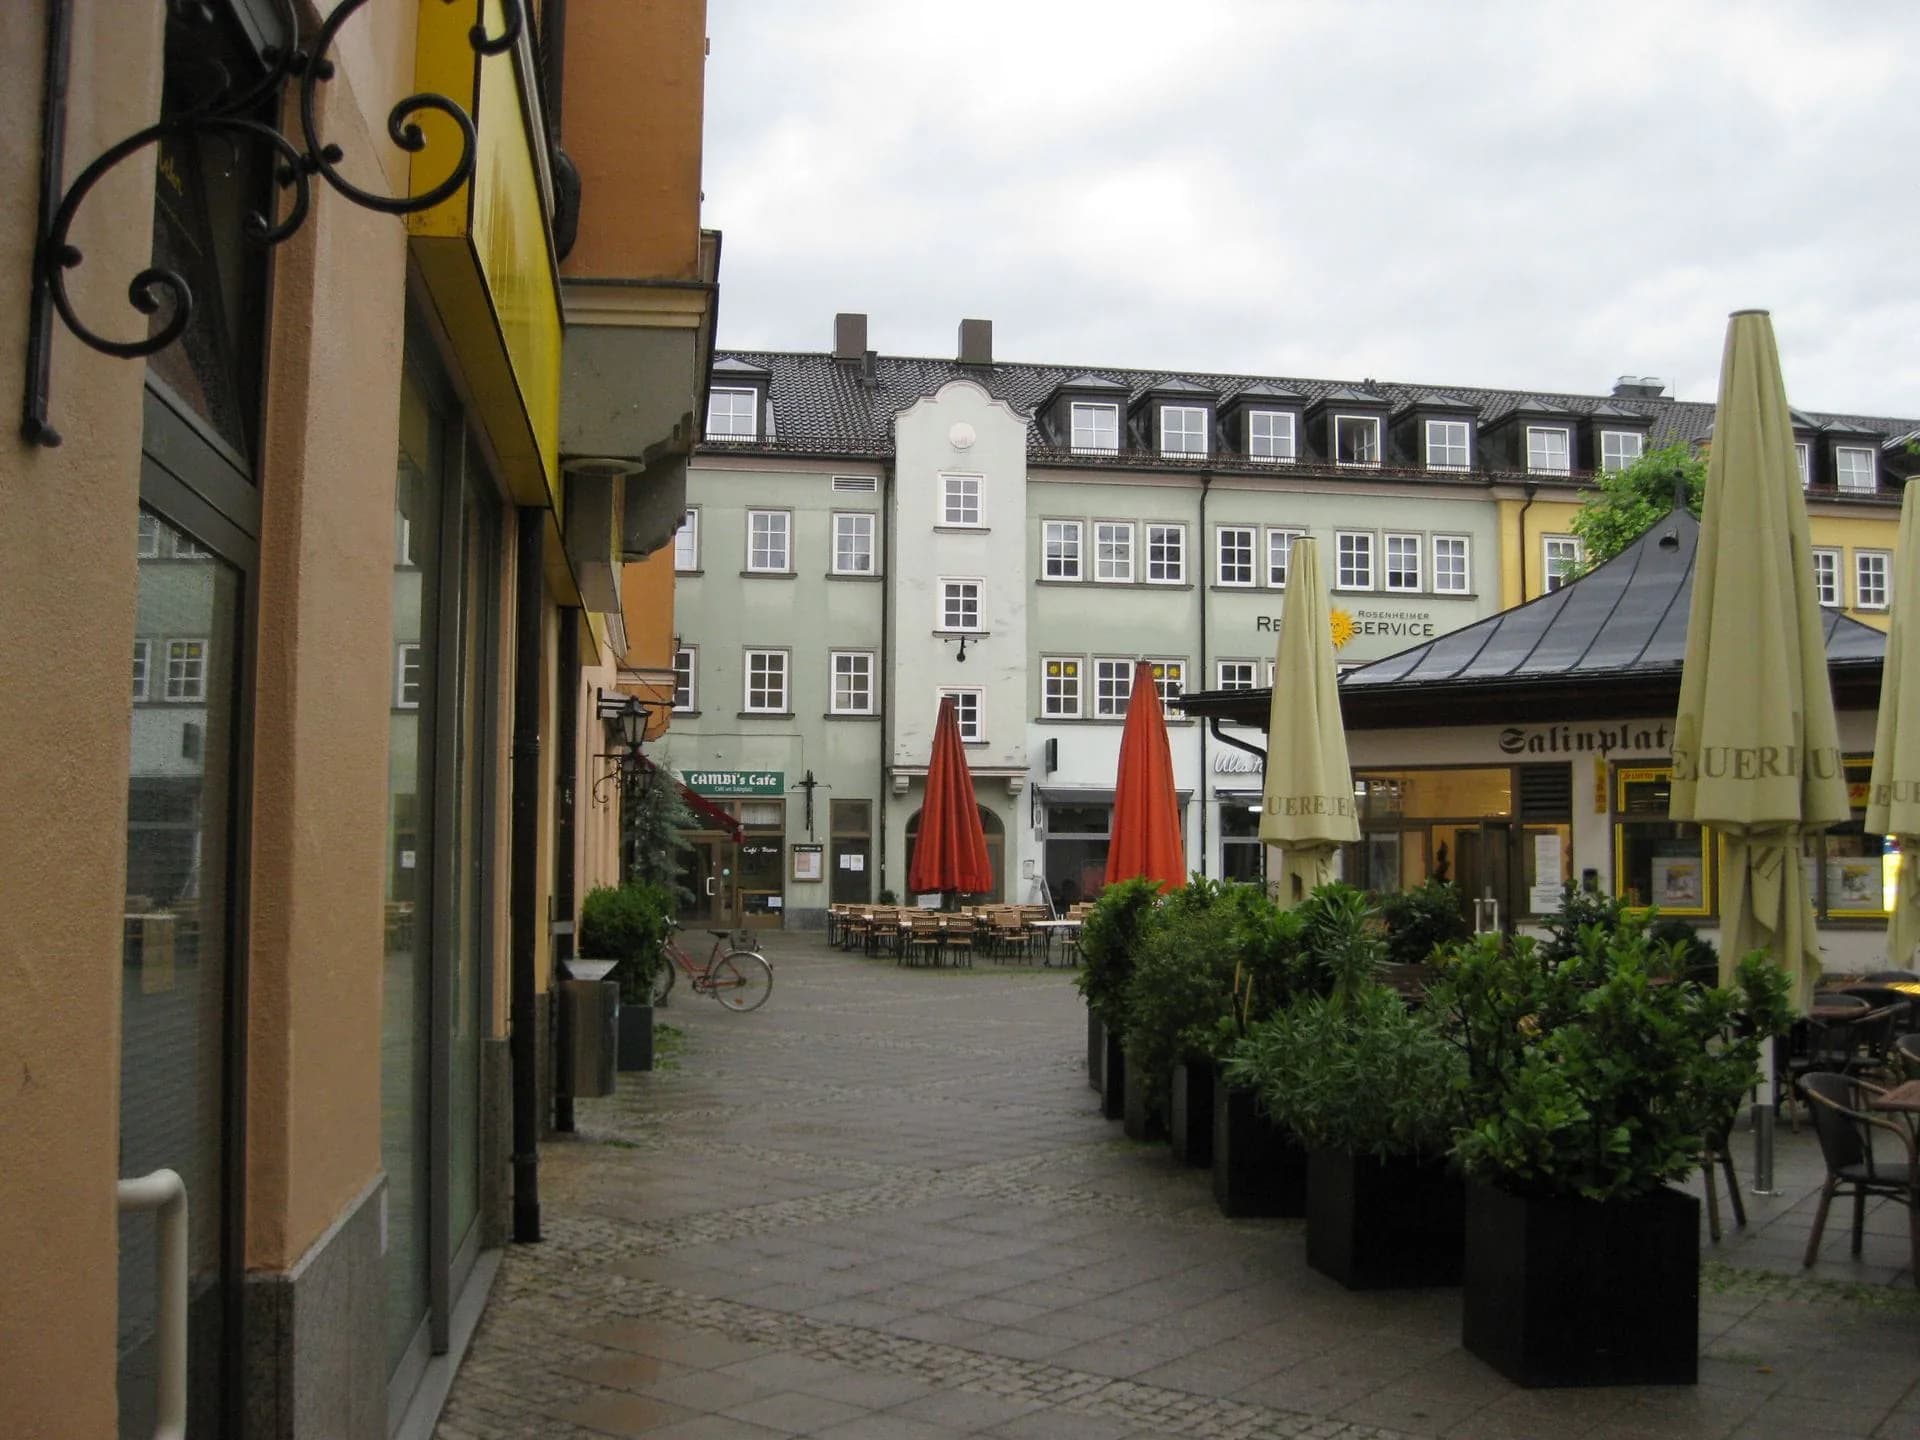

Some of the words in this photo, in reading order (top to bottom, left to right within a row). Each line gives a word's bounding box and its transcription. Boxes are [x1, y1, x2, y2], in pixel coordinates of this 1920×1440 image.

[1256, 616, 1282, 633] RE
[1350, 620, 1434, 637] SERVICE
[1499, 722, 1677, 759] Salinplat
